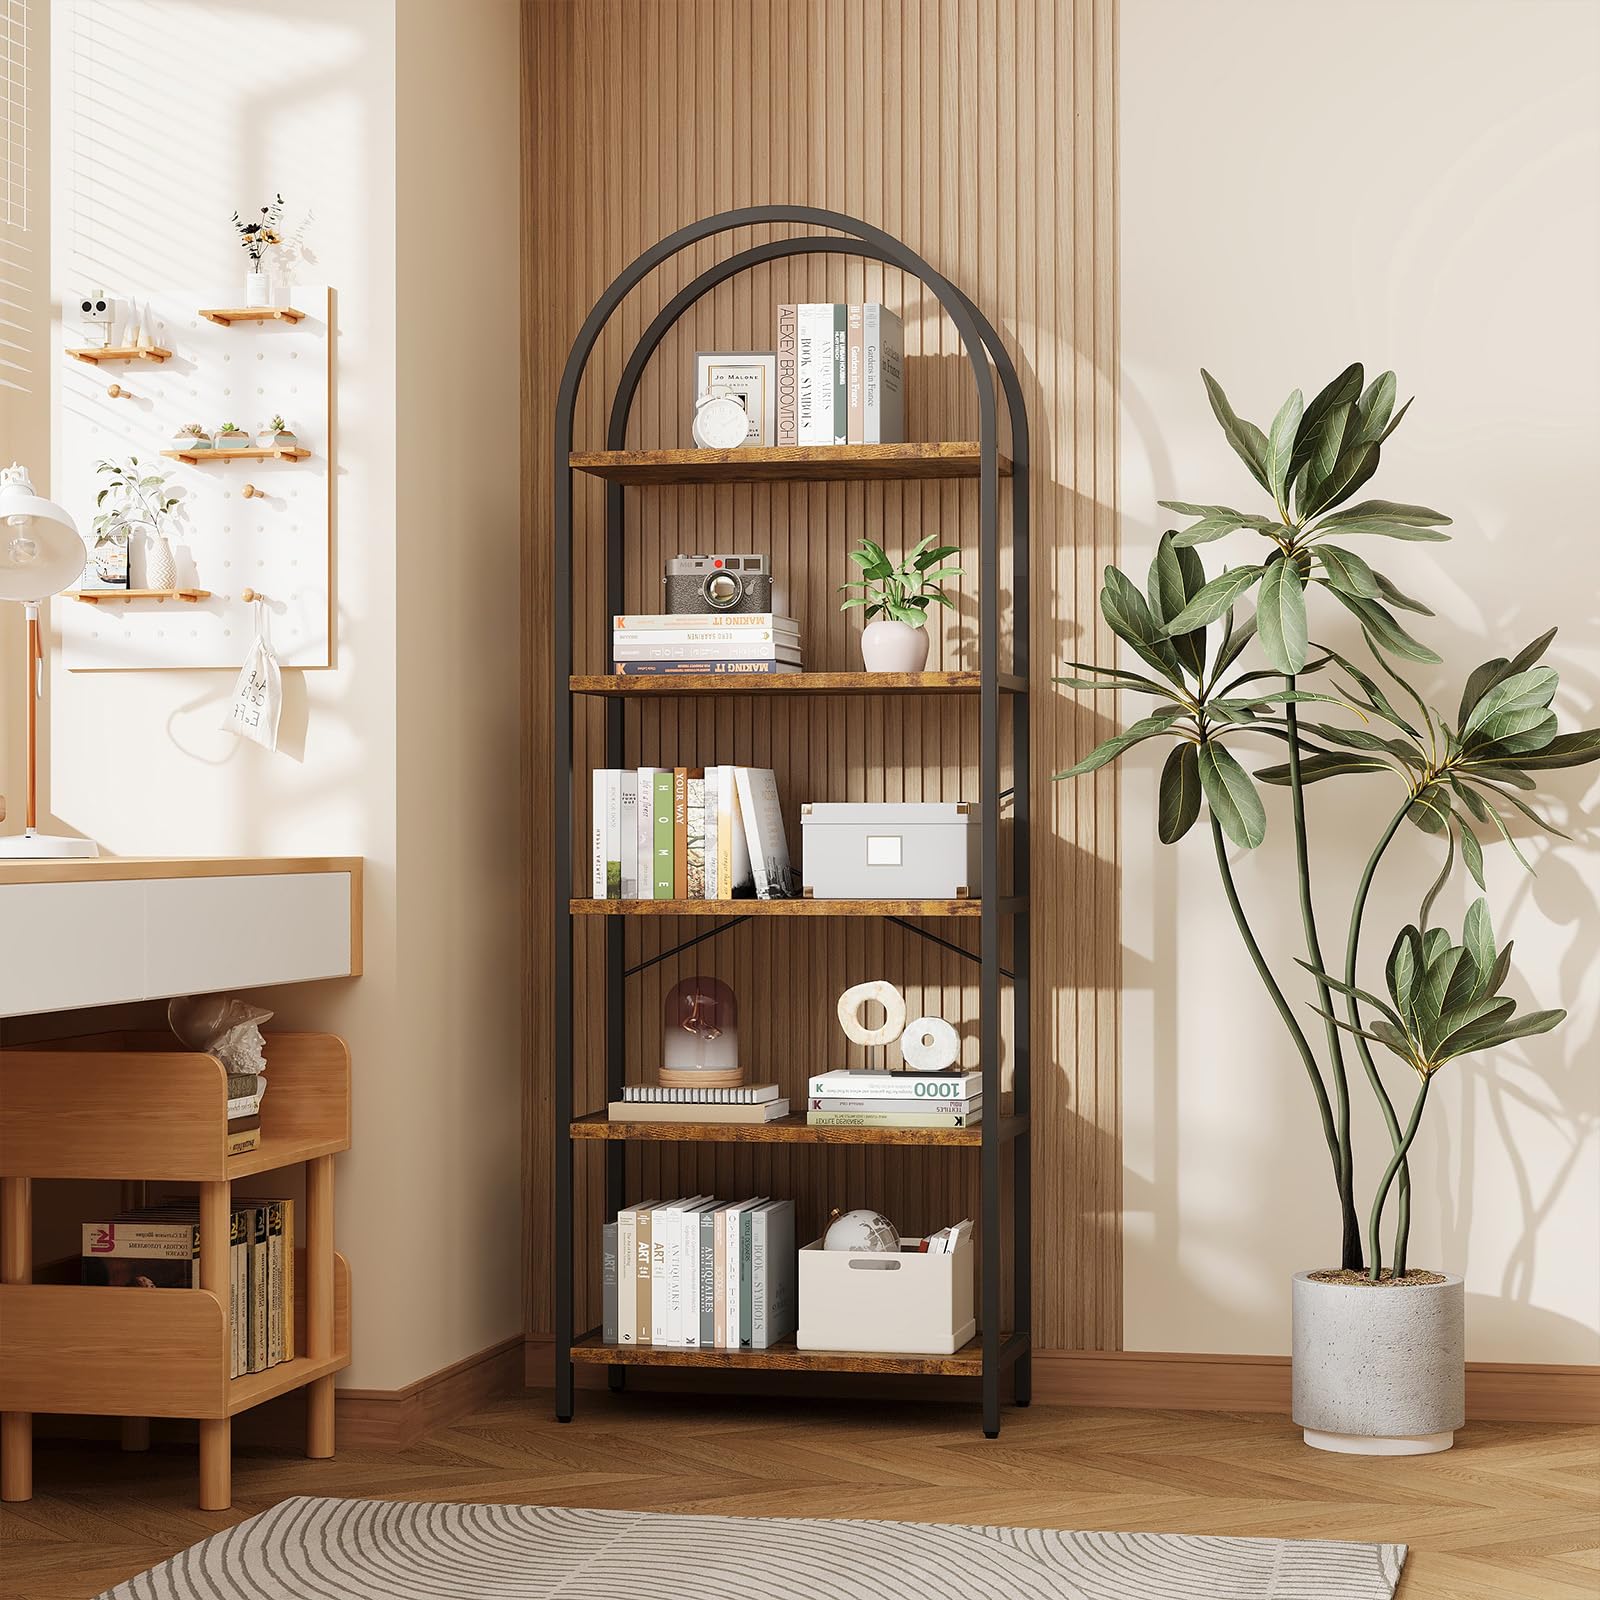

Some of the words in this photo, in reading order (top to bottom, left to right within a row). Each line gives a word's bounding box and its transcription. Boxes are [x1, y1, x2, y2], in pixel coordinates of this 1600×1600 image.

[780, 308, 794, 356] ALEXEY
[800, 338, 812, 366] BOOK
[851, 346, 860, 374] Gardens
[868, 345, 876, 374] Gardens
[820, 340, 832, 410] ANTIQUAIRES
[780, 360, 795, 439] BRODOVITCH
[800, 377, 812, 428] SYMBOLS
[851, 383, 860, 408] France
[868, 384, 876, 407] France
[616, 616, 626, 629] K
[712, 616, 724, 626] IT
[725, 616, 764, 625] MAKING
[687, 632, 716, 640] SAARINEN
[616, 663, 626, 676] K
[714, 663, 727, 673] IT
[727, 663, 770, 673] MAKING
[676, 772, 684, 801] YOUR
[676, 804, 684, 825] WAY
[658, 785, 669, 887] HOME
[816, 1083, 824, 1093] K
[914, 1082, 960, 1098] 1000
[812, 1100, 822, 1110] K
[605, 1252, 615, 1272] ART
[638, 1242, 650, 1264] ART
[654, 1242, 664, 1264] ART
[754, 1245, 763, 1272] BOOK
[670, 1242, 680, 1312] ANTIQUAIRES
[704, 1246, 713, 1313] ANTIQUAIRES
[754, 1282, 763, 1330] SYMBOLS
[741, 1338, 750, 1346] K
